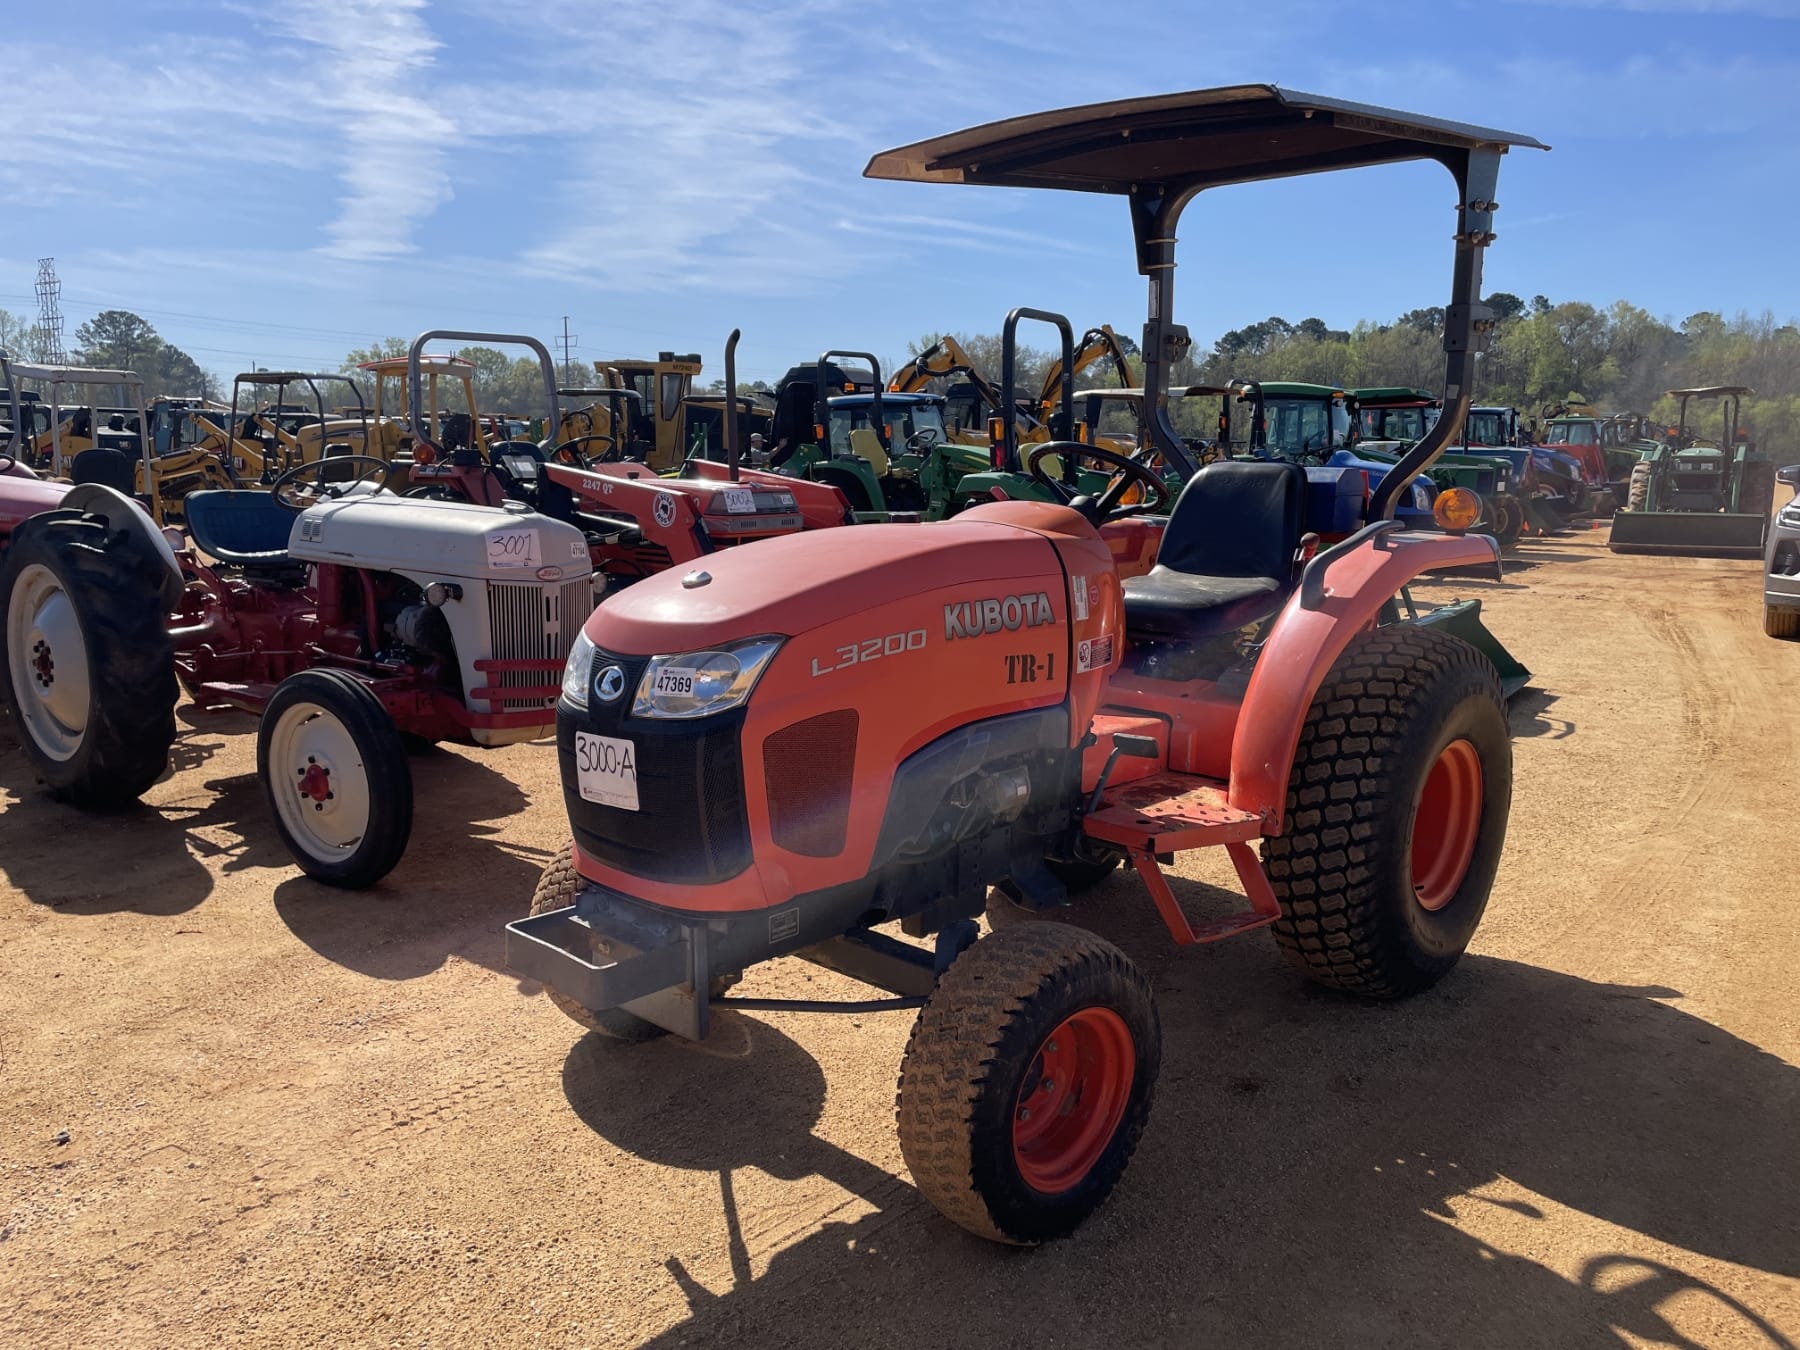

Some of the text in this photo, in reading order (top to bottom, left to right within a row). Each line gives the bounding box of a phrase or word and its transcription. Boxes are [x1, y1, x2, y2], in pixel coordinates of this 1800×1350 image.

[582, 478, 615, 495] 2247 QT
[724, 490, 753, 507] 3002
[489, 533, 532, 561] 3001
[944, 592, 1056, 641] KUBOTA
[811, 628, 927, 677] L3200
[1005, 653, 1054, 684] TR-1
[657, 676, 692, 693] 47369
